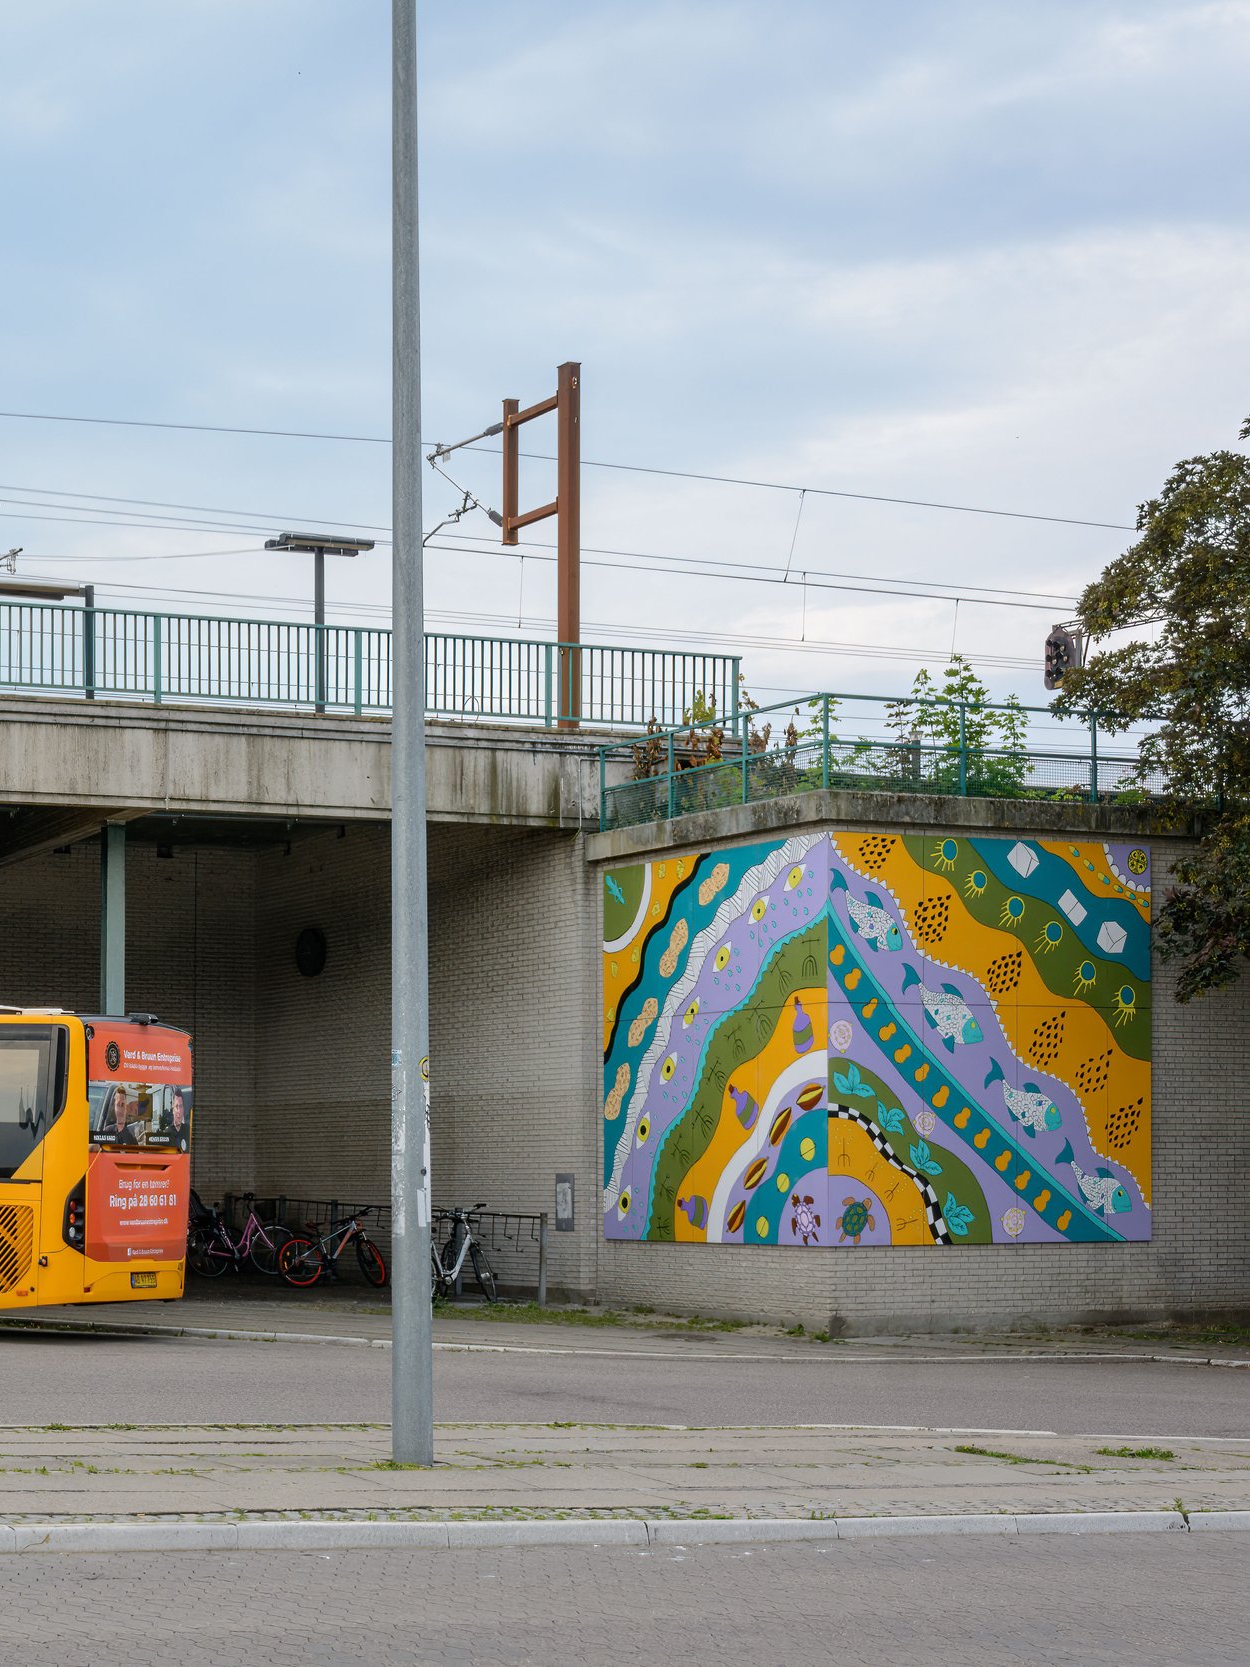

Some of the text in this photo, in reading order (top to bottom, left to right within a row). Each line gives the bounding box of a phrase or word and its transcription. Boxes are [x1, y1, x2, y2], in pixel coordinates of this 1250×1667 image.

[118, 1180, 132, 1190] Brug
[110, 1194, 177, 1210] Ring på 28 60 61 81
